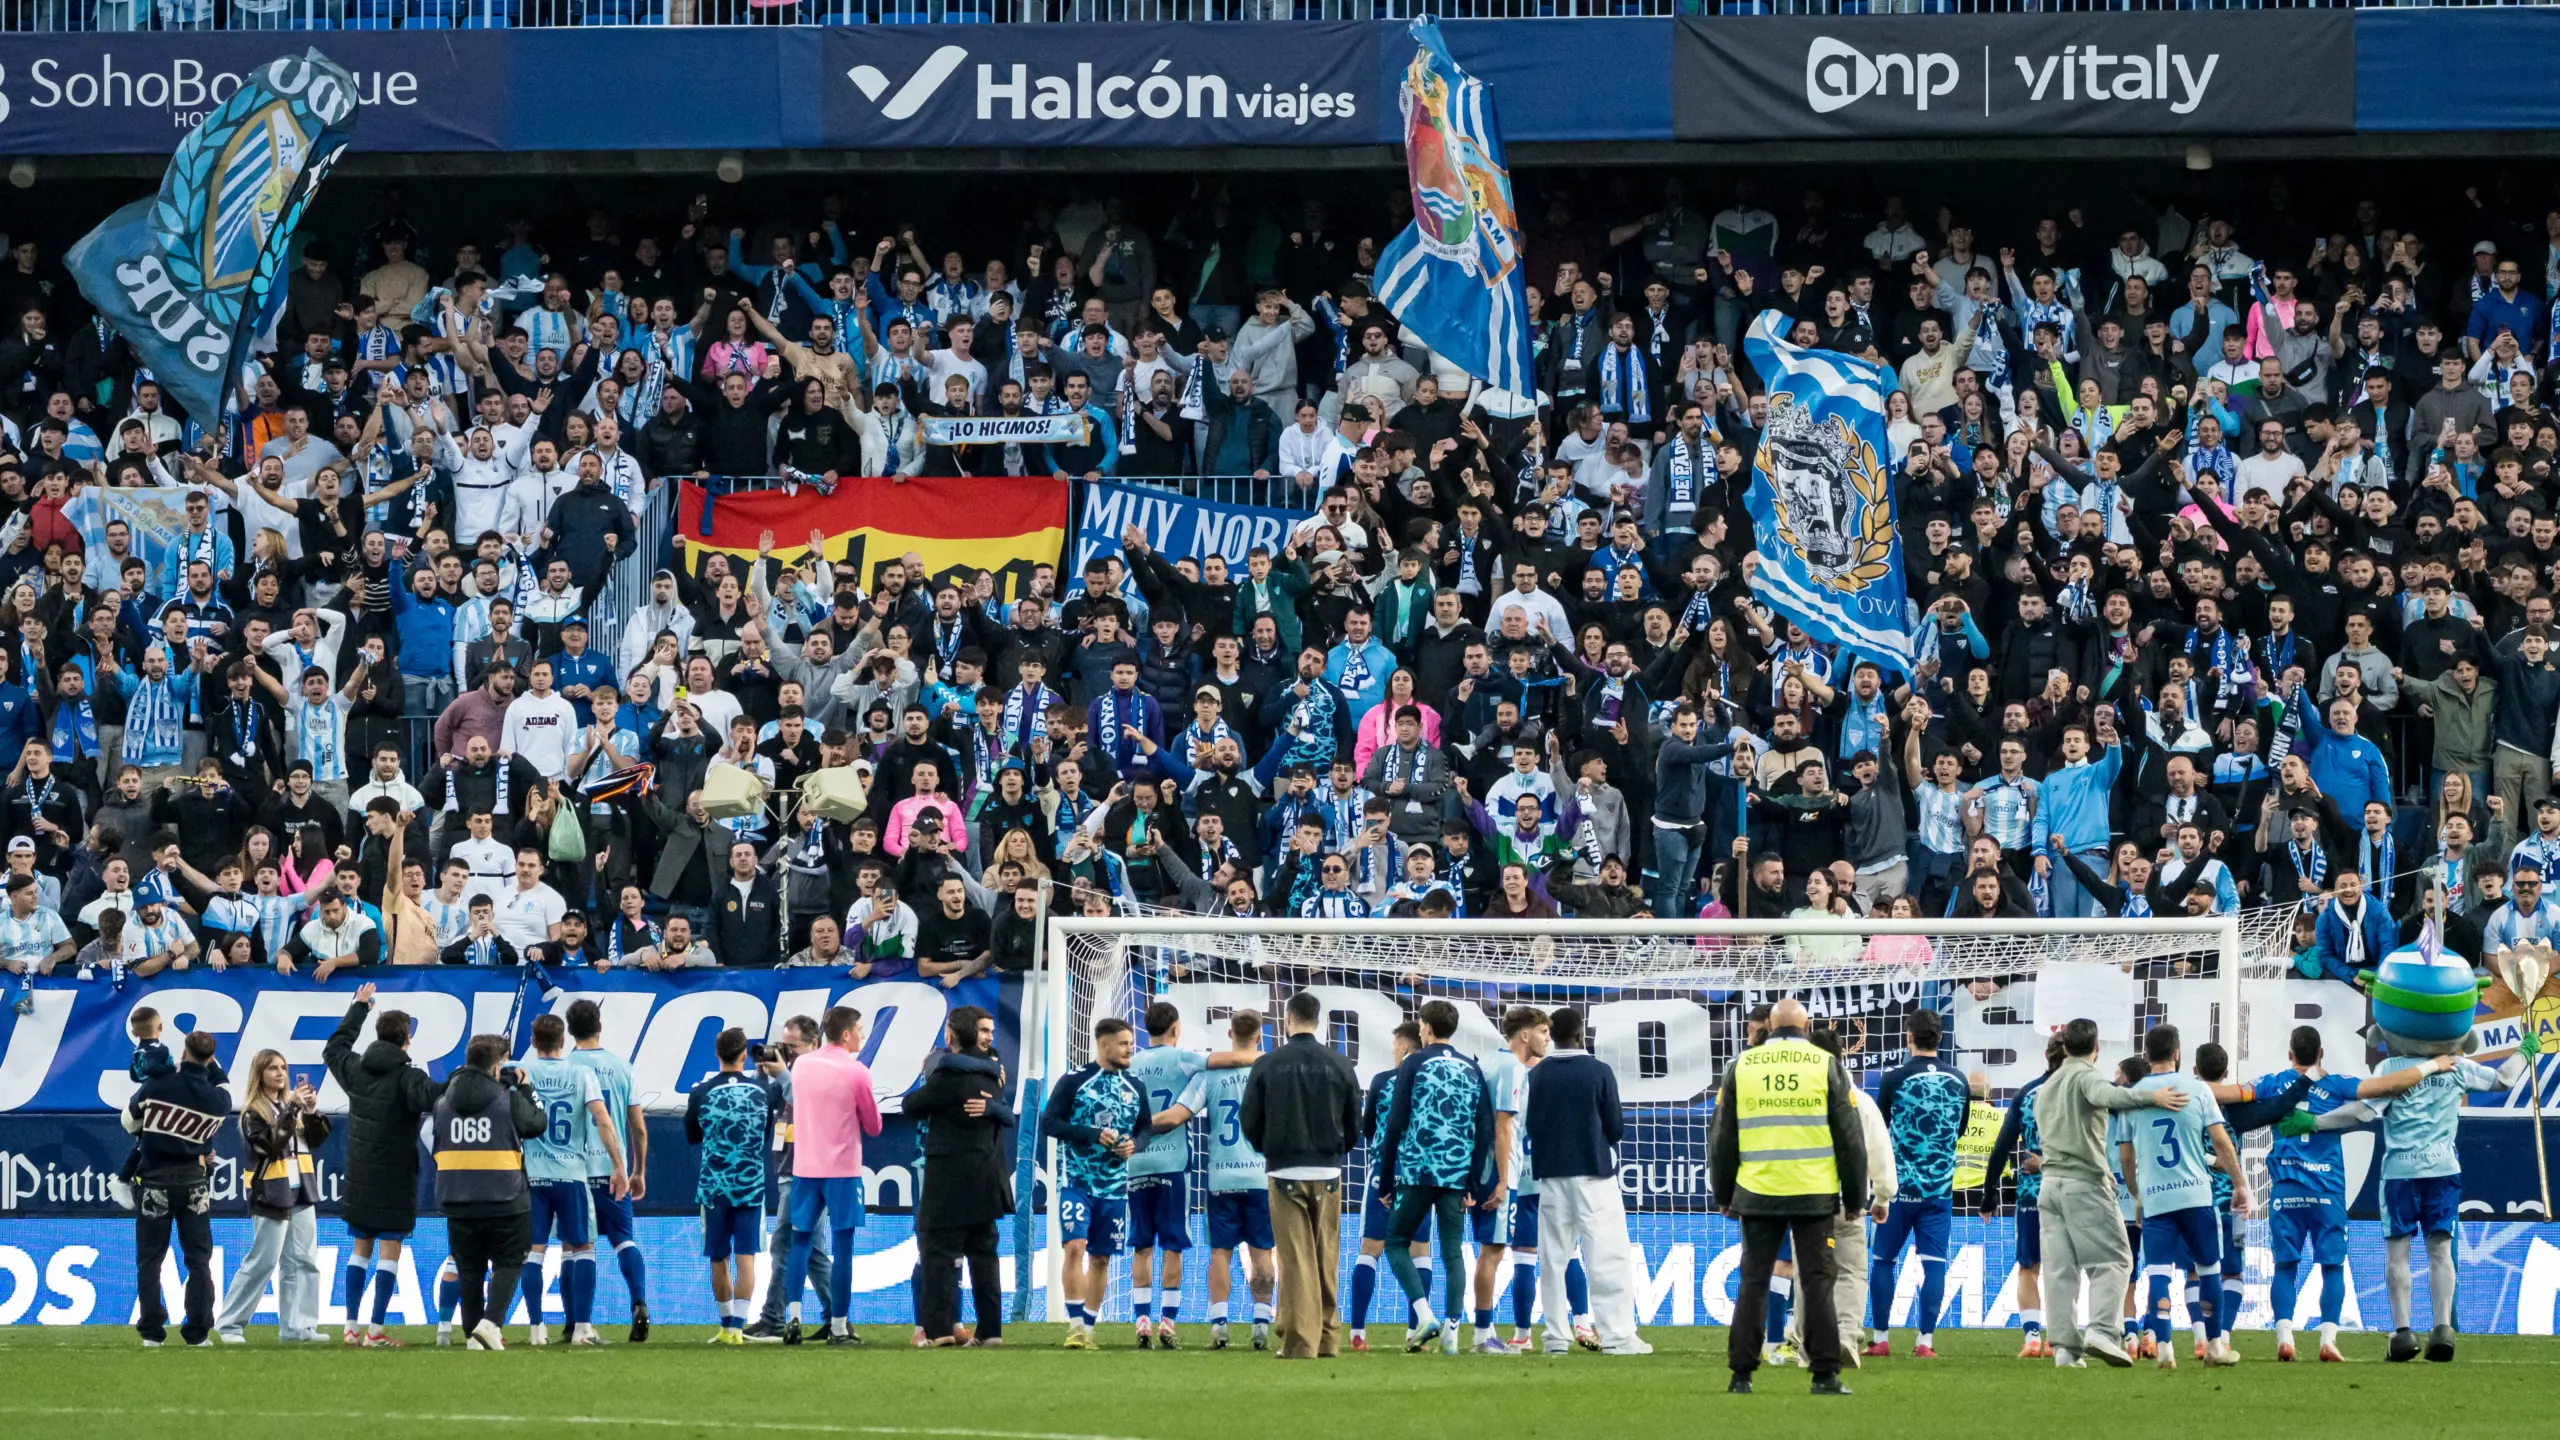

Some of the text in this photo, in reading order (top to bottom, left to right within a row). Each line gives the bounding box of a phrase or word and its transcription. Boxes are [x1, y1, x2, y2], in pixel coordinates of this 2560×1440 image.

[30, 53, 418, 108] SohoBoue
[976, 59, 1228, 120] Halcón
[1236, 84, 1357, 126] viajes
[949, 419, 1051, 443] ¡LO HICIMOS!
[1081, 484, 1184, 553] MUY
[1785, 972, 1918, 1018] CALLEJO
[1745, 1050, 1821, 1067] SEGURIDAD
[1762, 1073, 1799, 1092] 185
[1758, 1097, 1822, 1109] PROSEGUR
[450, 1116, 492, 1144] 068
[2152, 1117, 2181, 1169] 3
[1215, 1161, 1266, 1170] BENAHAVI
[1061, 1200, 1086, 1222] 22
